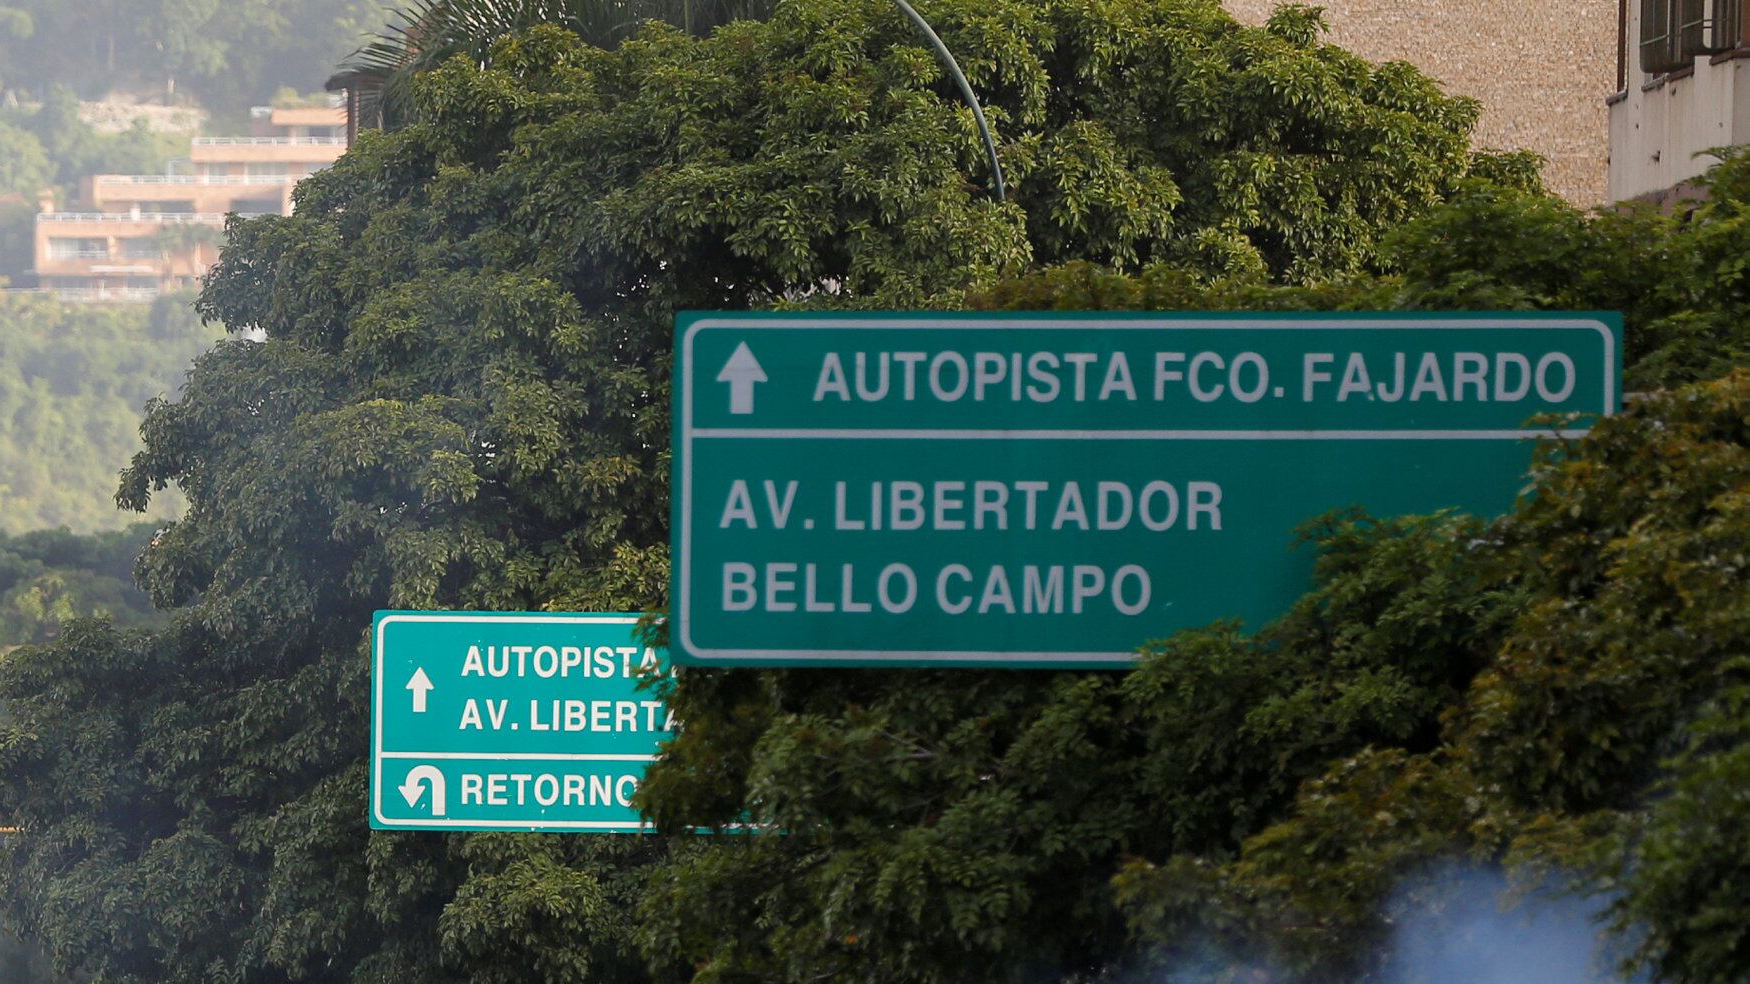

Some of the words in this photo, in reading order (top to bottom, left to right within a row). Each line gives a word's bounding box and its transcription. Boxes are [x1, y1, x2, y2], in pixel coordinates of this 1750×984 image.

[813, 351, 1137, 402] AUTOPISTA
[1154, 351, 1285, 402] FCO.
[1303, 351, 1577, 402] FAJARDO
[719, 480, 814, 530] AV.
[835, 480, 1223, 531] LIBERTADOR
[722, 563, 918, 615] BELLO
[936, 564, 1152, 616] CAMPO
[461, 645, 661, 679] AUTOPISTA
[458, 698, 519, 730] AV.
[460, 773, 638, 807] RETORNO
